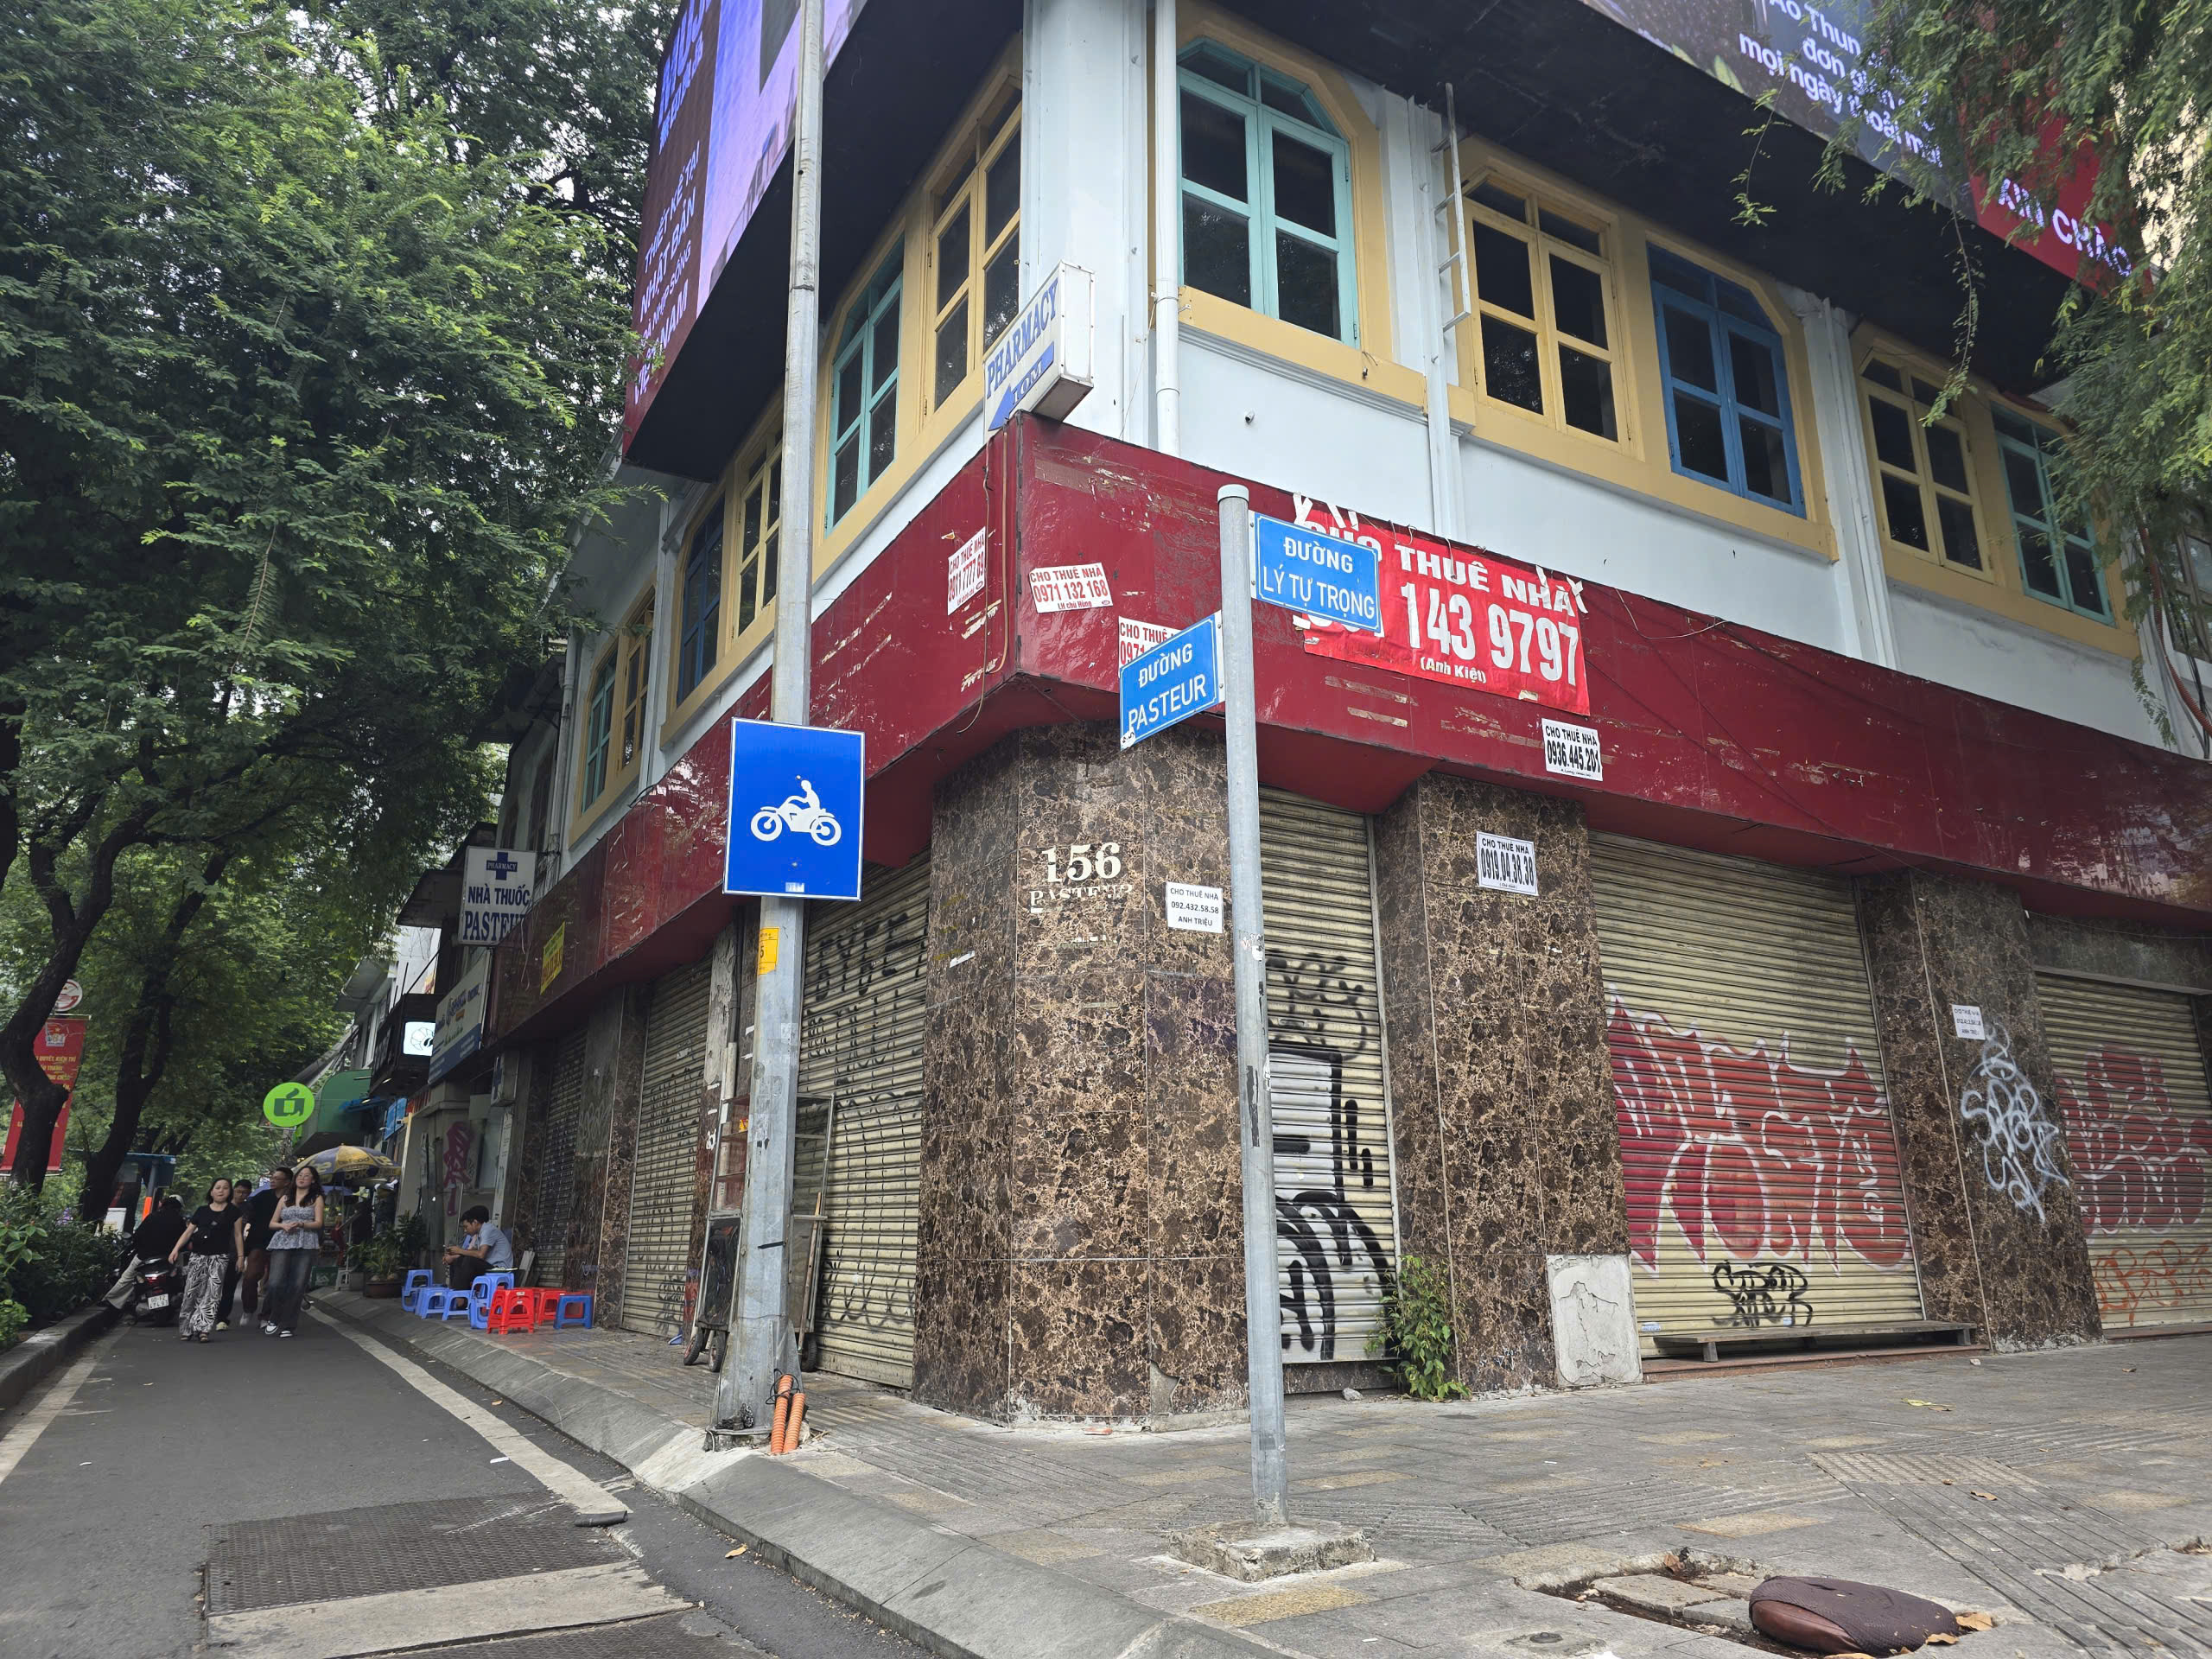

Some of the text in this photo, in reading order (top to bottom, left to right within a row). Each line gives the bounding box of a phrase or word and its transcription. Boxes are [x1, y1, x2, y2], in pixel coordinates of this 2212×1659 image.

[1804, 3, 1861, 55] Thun
[658, 0, 712, 129] MUJ
[1739, 33, 1784, 76] mọi
[1789, 63, 1842, 114] ngày
[1803, 37, 1846, 78] đơn
[645, 140, 700, 273] THIẾT KẾ TẠI
[640, 186, 696, 322] NHẬT BẢN
[660, 278, 689, 349] NAM
[987, 277, 1058, 399] PHARMACY
[950, 556, 960, 575] CHO
[961, 541, 974, 563] THUÊ
[1029, 564, 1103, 583] CHO THUÊ NHÀ
[1283, 537, 1353, 574] ĐƯỜNG
[1032, 579, 1108, 603] 0971 132 168
[1263, 563, 1375, 620] LÝ TỰ TRỌNG
[1394, 543, 1576, 618] THUÊ NHÀ
[1120, 622, 1167, 644] CHO THUÊ
[1401, 582, 1579, 687] 143 9797
[1138, 643, 1192, 689] ĐƯỜNG
[1421, 656, 1452, 676] (Anh
[1128, 673, 1206, 732] PASTEUR
[1545, 725, 1598, 746] CHO THUÊ NHÀ
[1547, 740, 1600, 773] 0936.445.201
[1041, 842, 1122, 883] 156
[1482, 837, 1529, 855] CHO THUÊ NHÀ
[487, 861, 517, 871] PHARMACY
[467, 883, 531, 906] NHÀ THUỐC
[1170, 887, 1219, 901] CHO THUÊ NHÀ
[1171, 901, 1219, 914] 092.432.58.58
[462, 911, 526, 941] PASTE
[1193, 918, 1213, 926] TRIỆU
